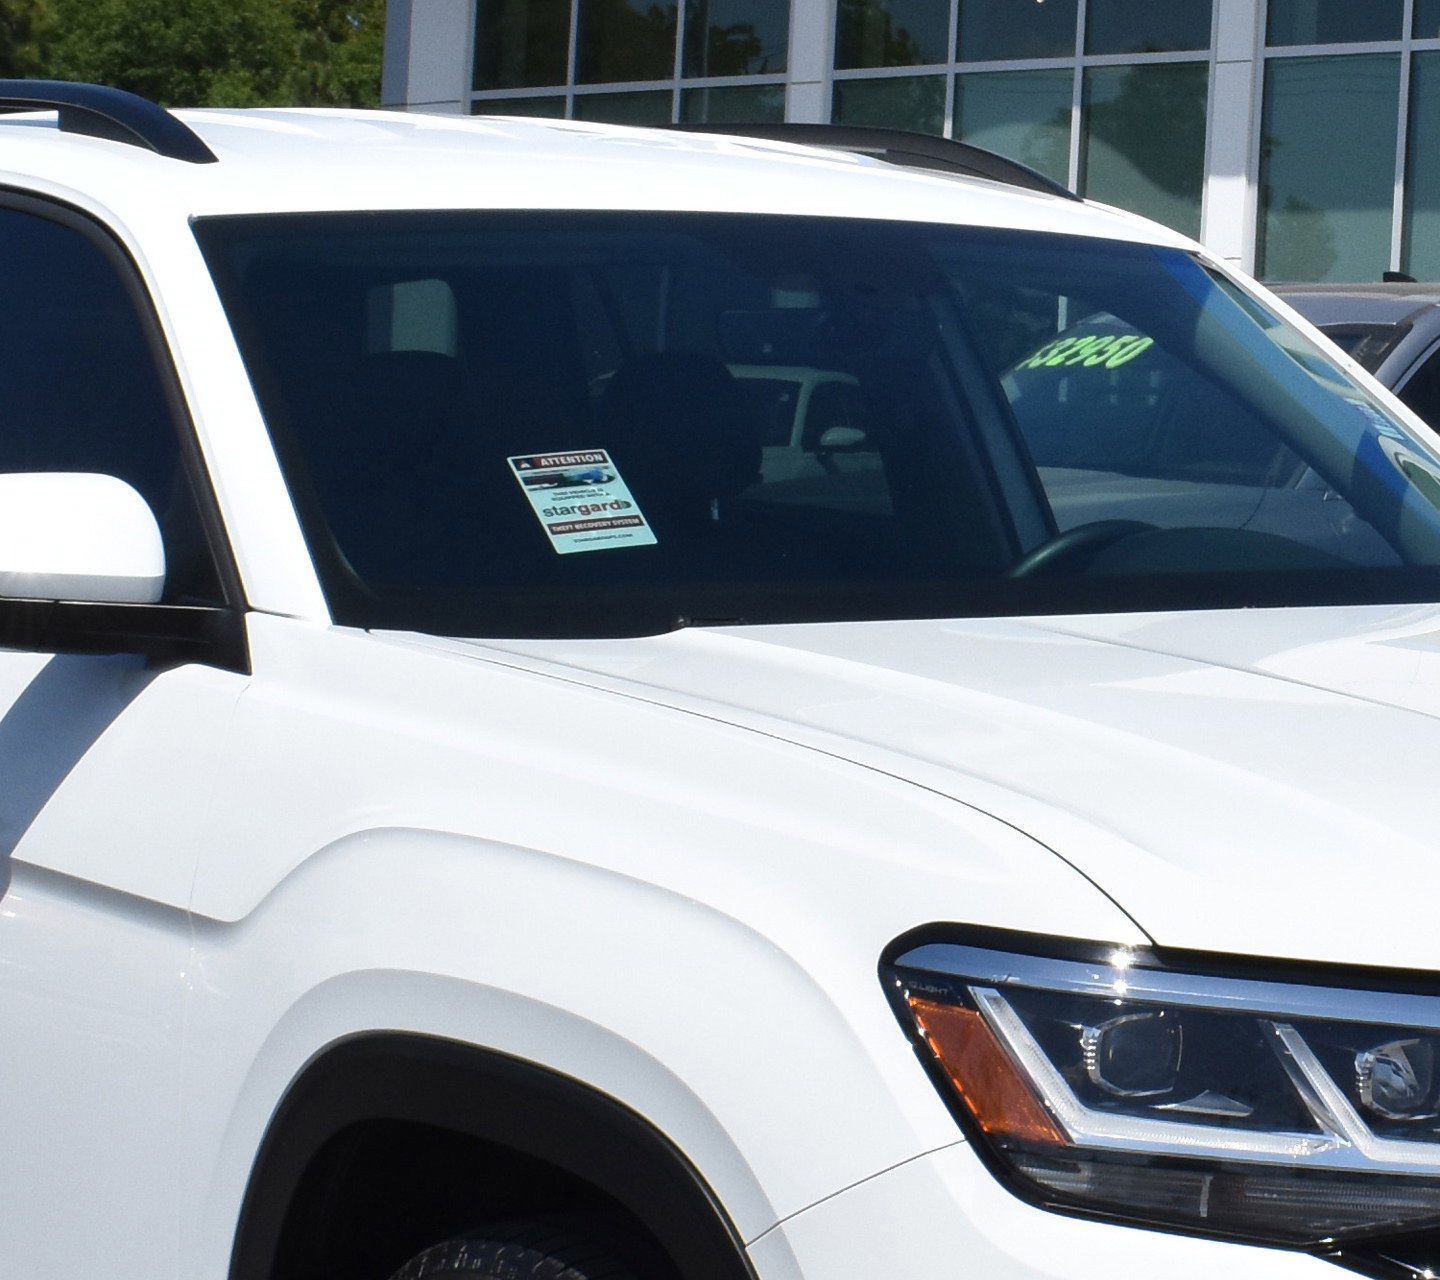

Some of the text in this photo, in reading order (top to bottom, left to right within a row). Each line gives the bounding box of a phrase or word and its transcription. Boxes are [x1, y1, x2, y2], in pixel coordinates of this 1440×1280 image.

[539, 452, 604, 467] ATTENTION
[542, 499, 622, 518] stargard
[574, 521, 612, 531] RECOVERY
